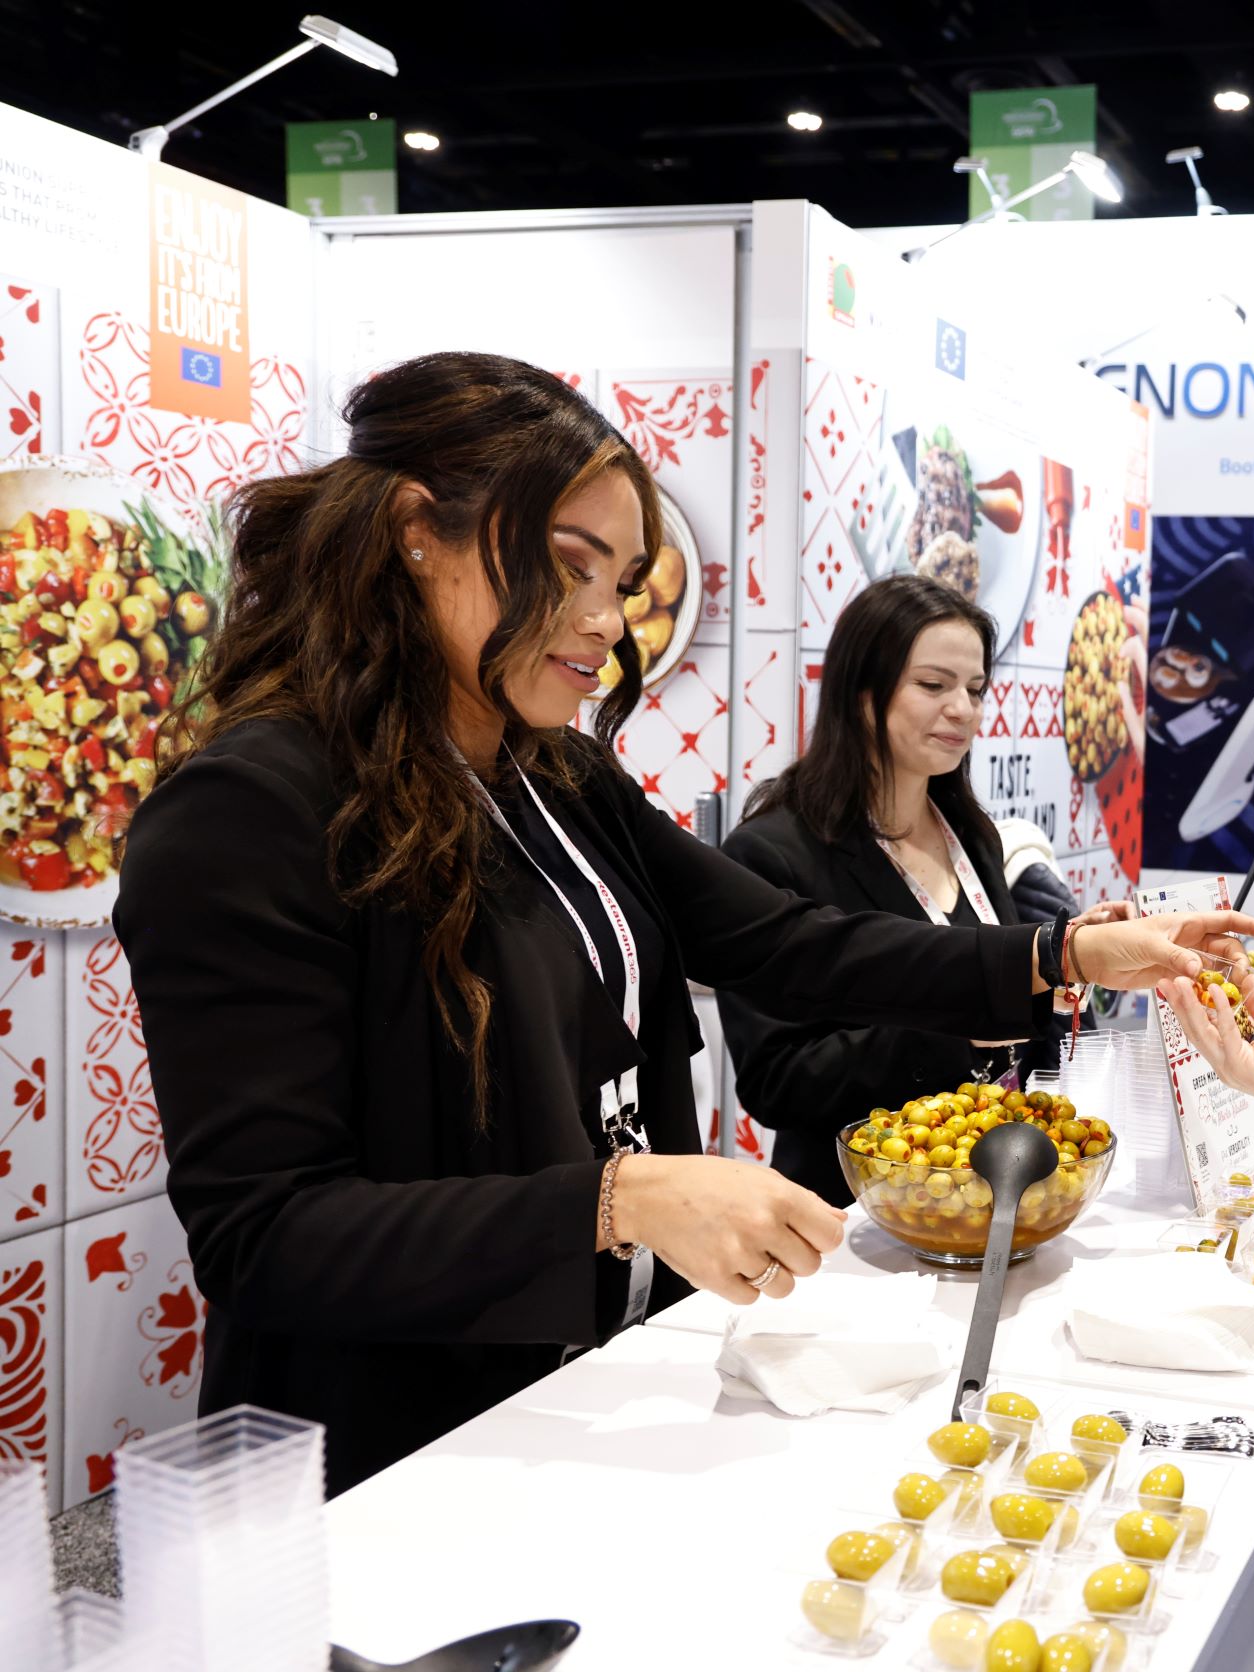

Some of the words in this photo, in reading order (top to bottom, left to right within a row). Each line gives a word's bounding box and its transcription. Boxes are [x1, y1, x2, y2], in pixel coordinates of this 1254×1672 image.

[0, 206, 40, 230] LTHY
[12, 185, 50, 208] THAT
[154, 183, 243, 268] ENJOY
[158, 245, 192, 290] IT'S
[196, 255, 241, 305] FROM
[158, 284, 243, 353] EUROPE
[990, 754, 1035, 800] TASTE,
